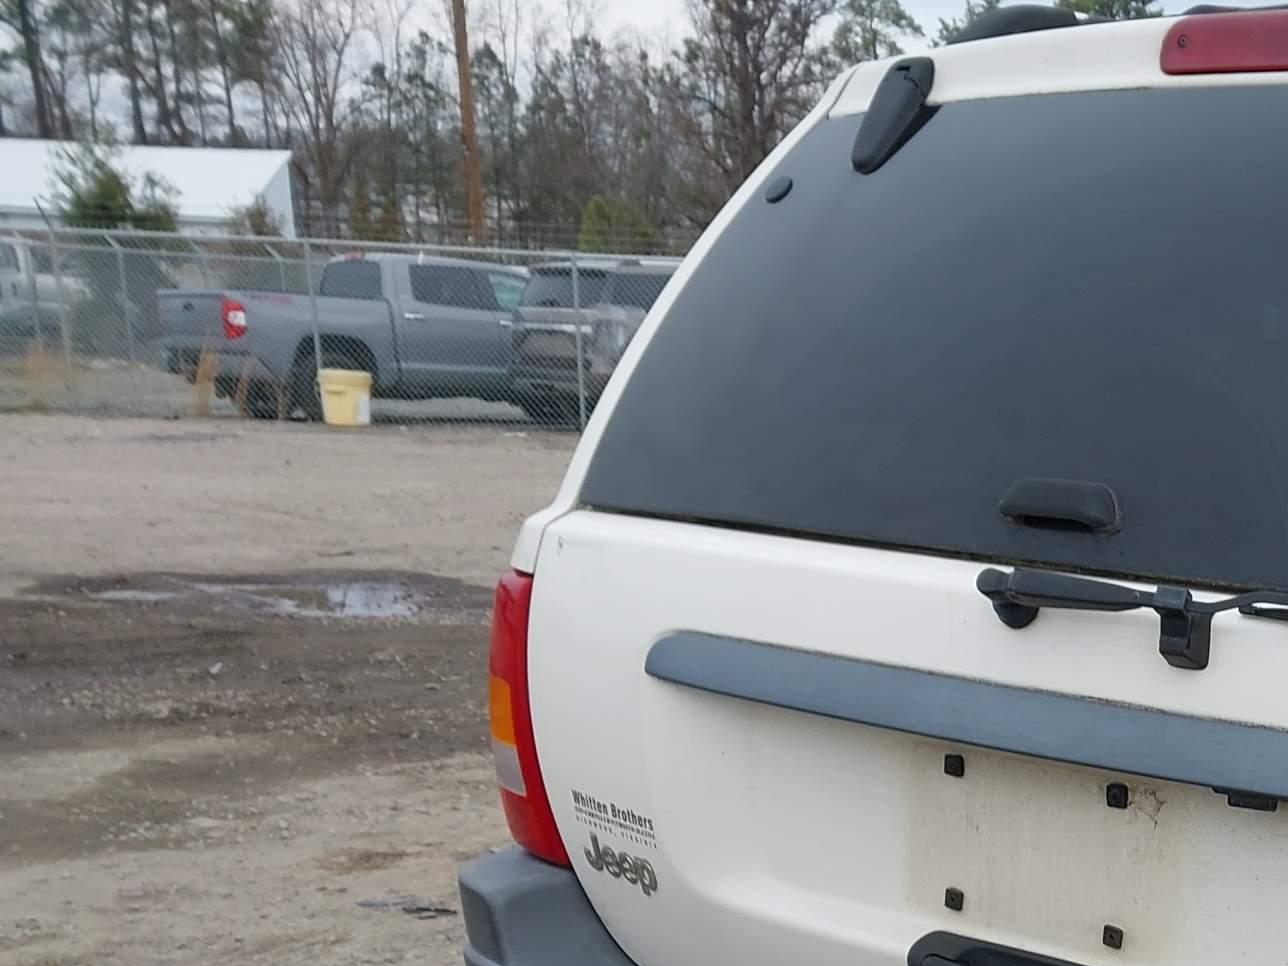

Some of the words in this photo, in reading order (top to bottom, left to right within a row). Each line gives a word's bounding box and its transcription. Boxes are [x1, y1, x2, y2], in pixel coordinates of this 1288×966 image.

[571, 788, 608, 815] Whitten
[610, 802, 654, 831] Brothers
[583, 831, 658, 896] Jeep
